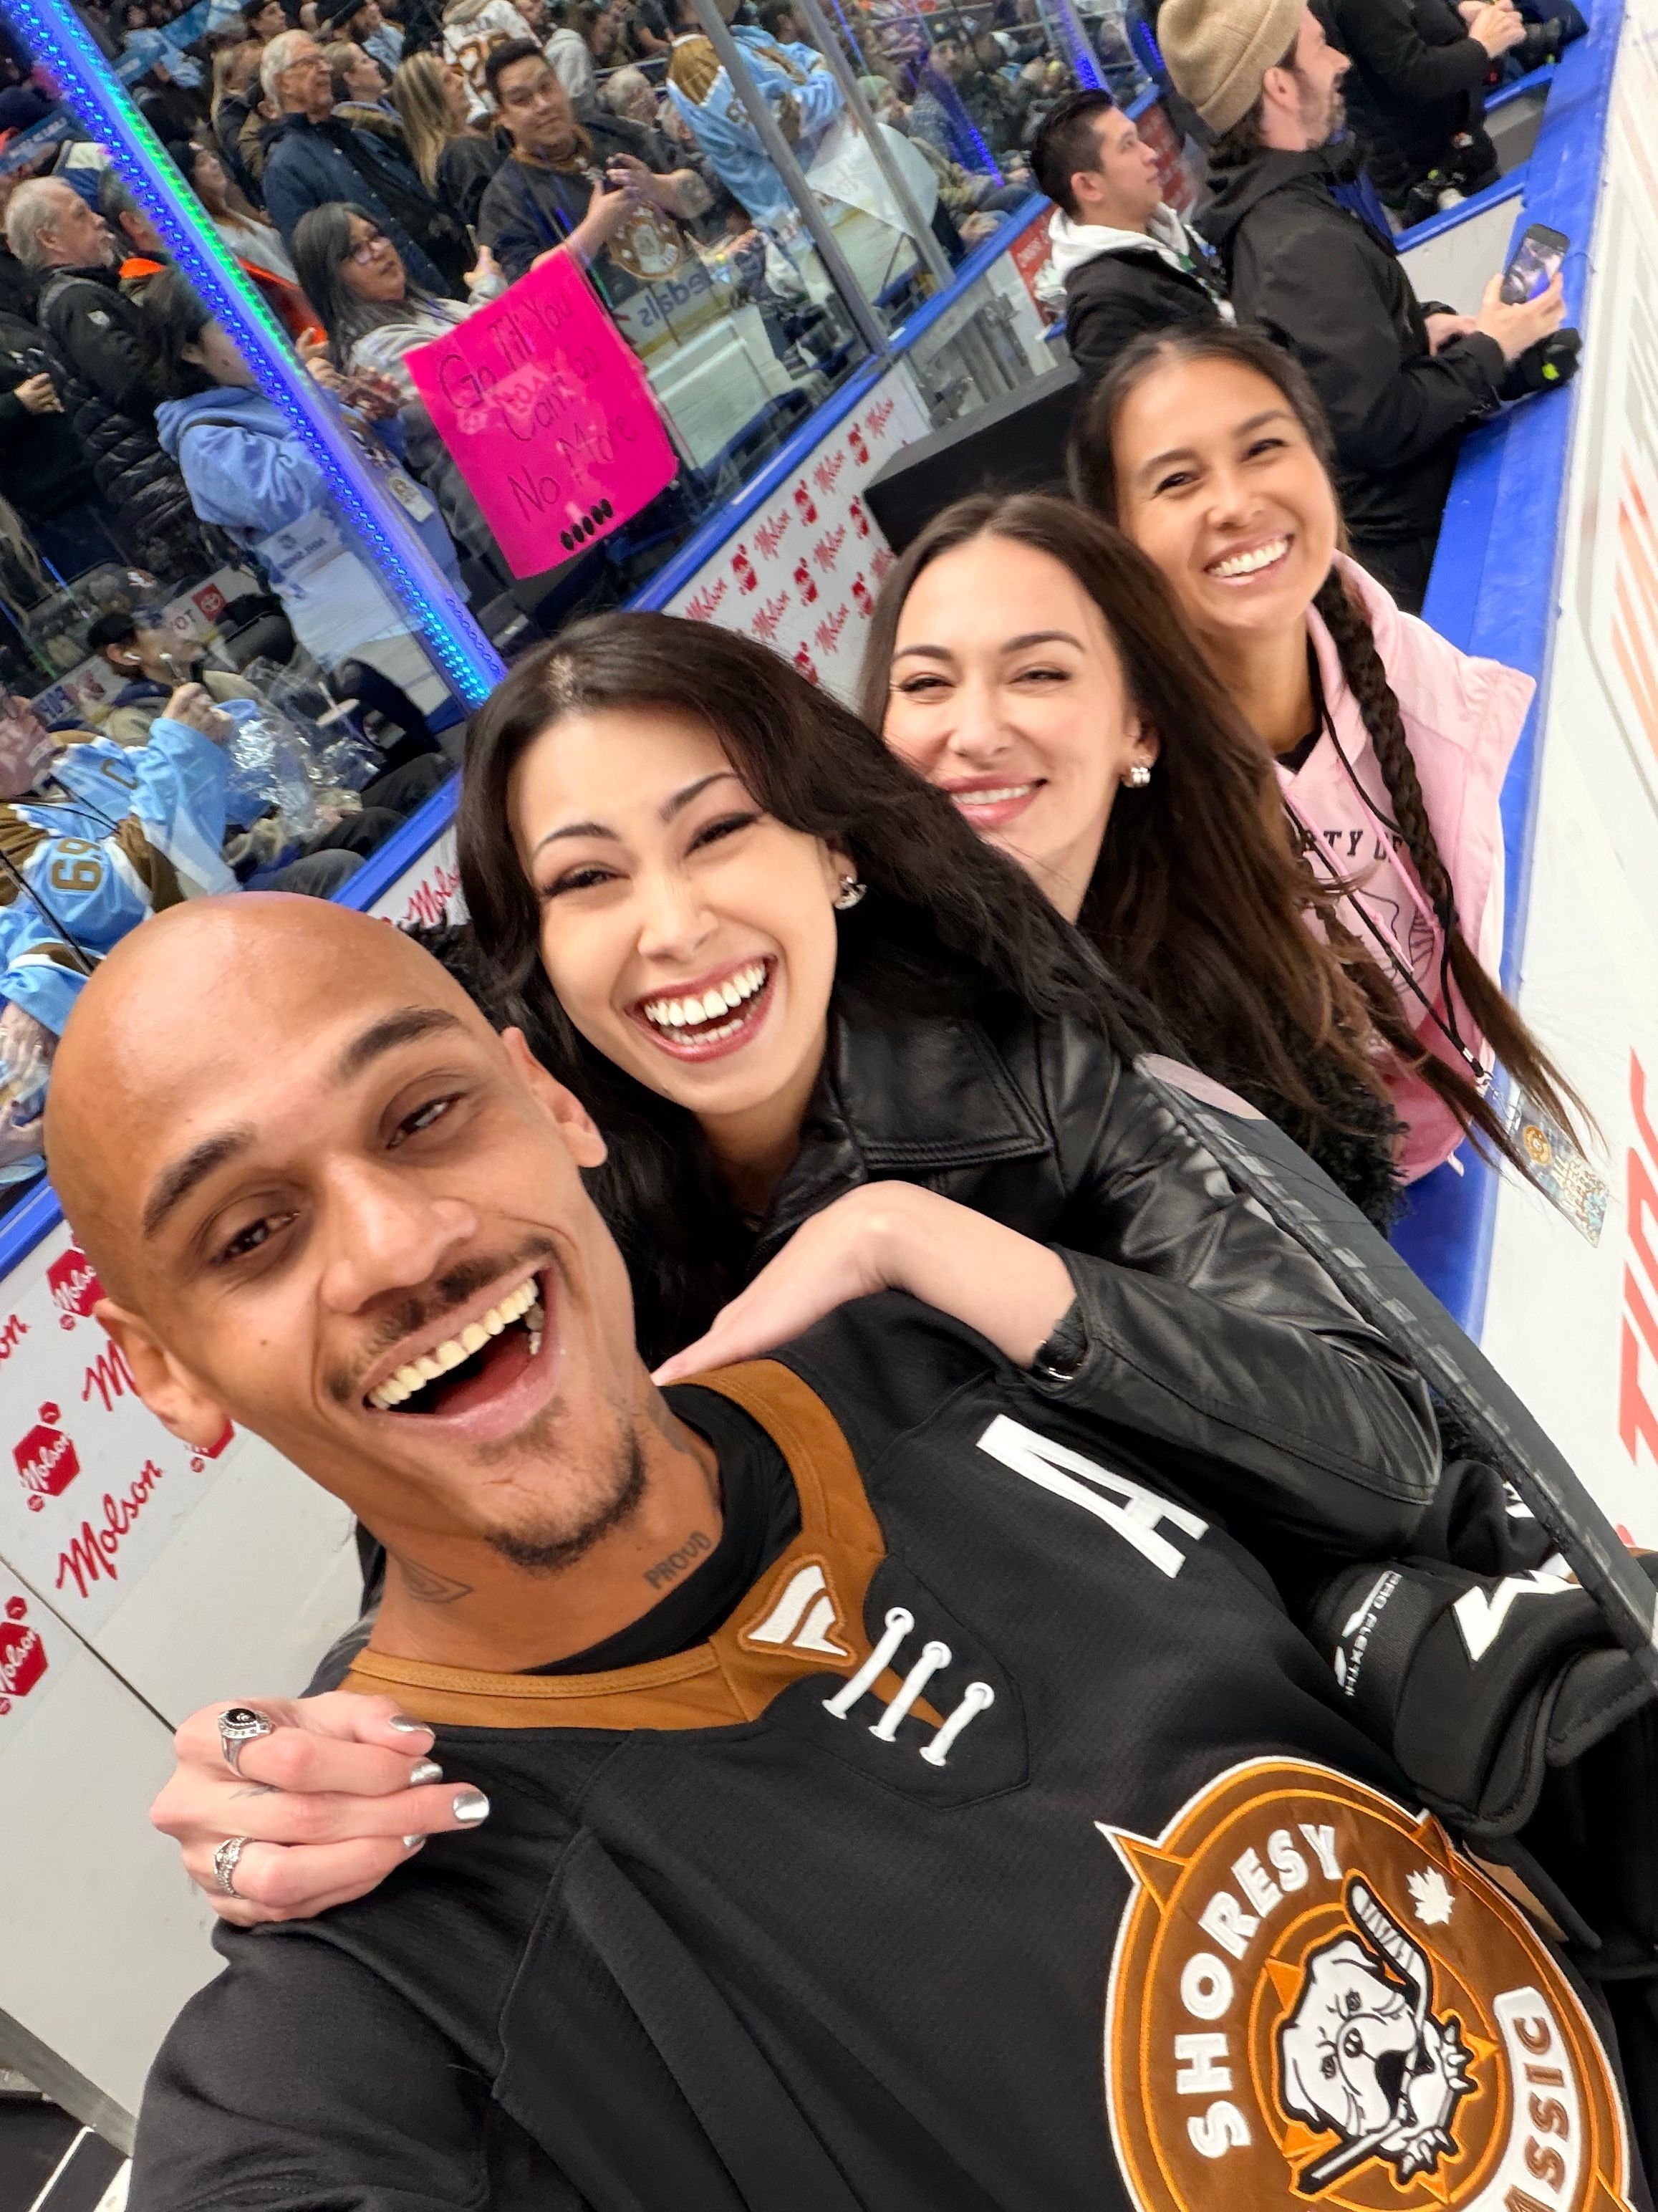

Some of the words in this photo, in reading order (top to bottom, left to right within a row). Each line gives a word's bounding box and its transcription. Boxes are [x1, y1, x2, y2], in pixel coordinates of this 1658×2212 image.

[438, 353, 498, 408] Go
[519, 291, 574, 335] You
[507, 464, 561, 523] No
[54, 1265, 97, 1312] Molso
[55, 1459, 163, 1599] Molson
[975, 1413, 1211, 1579] A
[643, 1531, 711, 1590] PROUD
[1175, 1823, 1345, 2159] SHORESY
